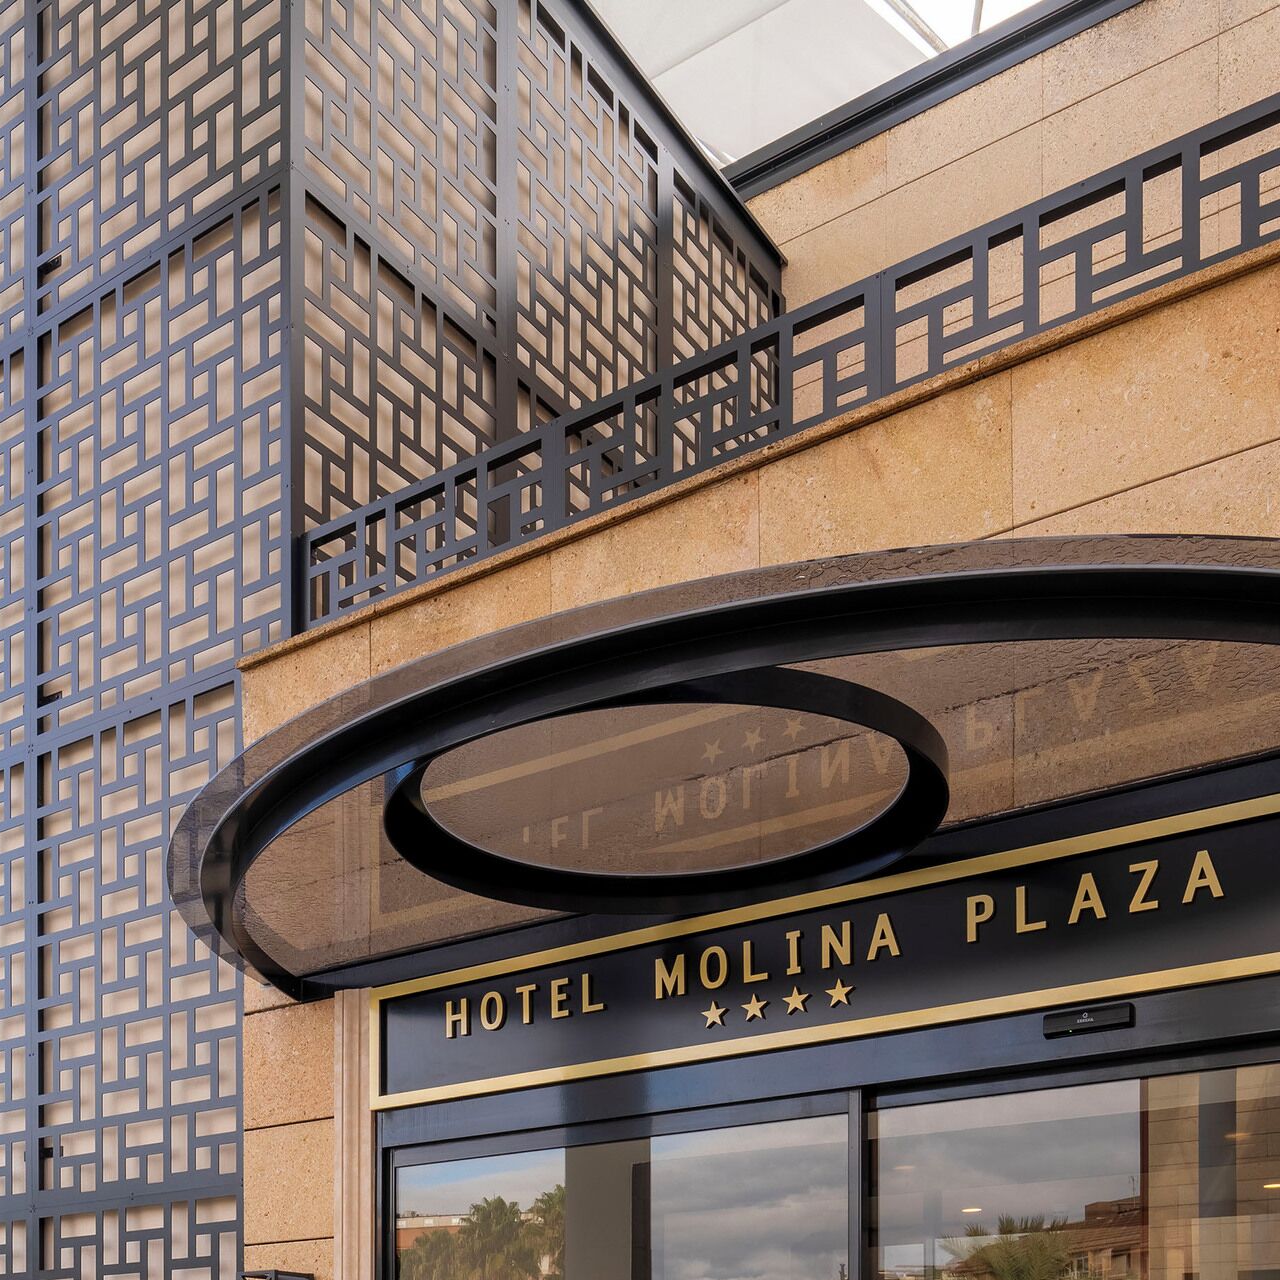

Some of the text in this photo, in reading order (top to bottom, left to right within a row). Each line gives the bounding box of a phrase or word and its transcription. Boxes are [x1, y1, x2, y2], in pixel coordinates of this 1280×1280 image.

[445, 849, 1224, 1039] HOTEL MOLINA PLAZA
